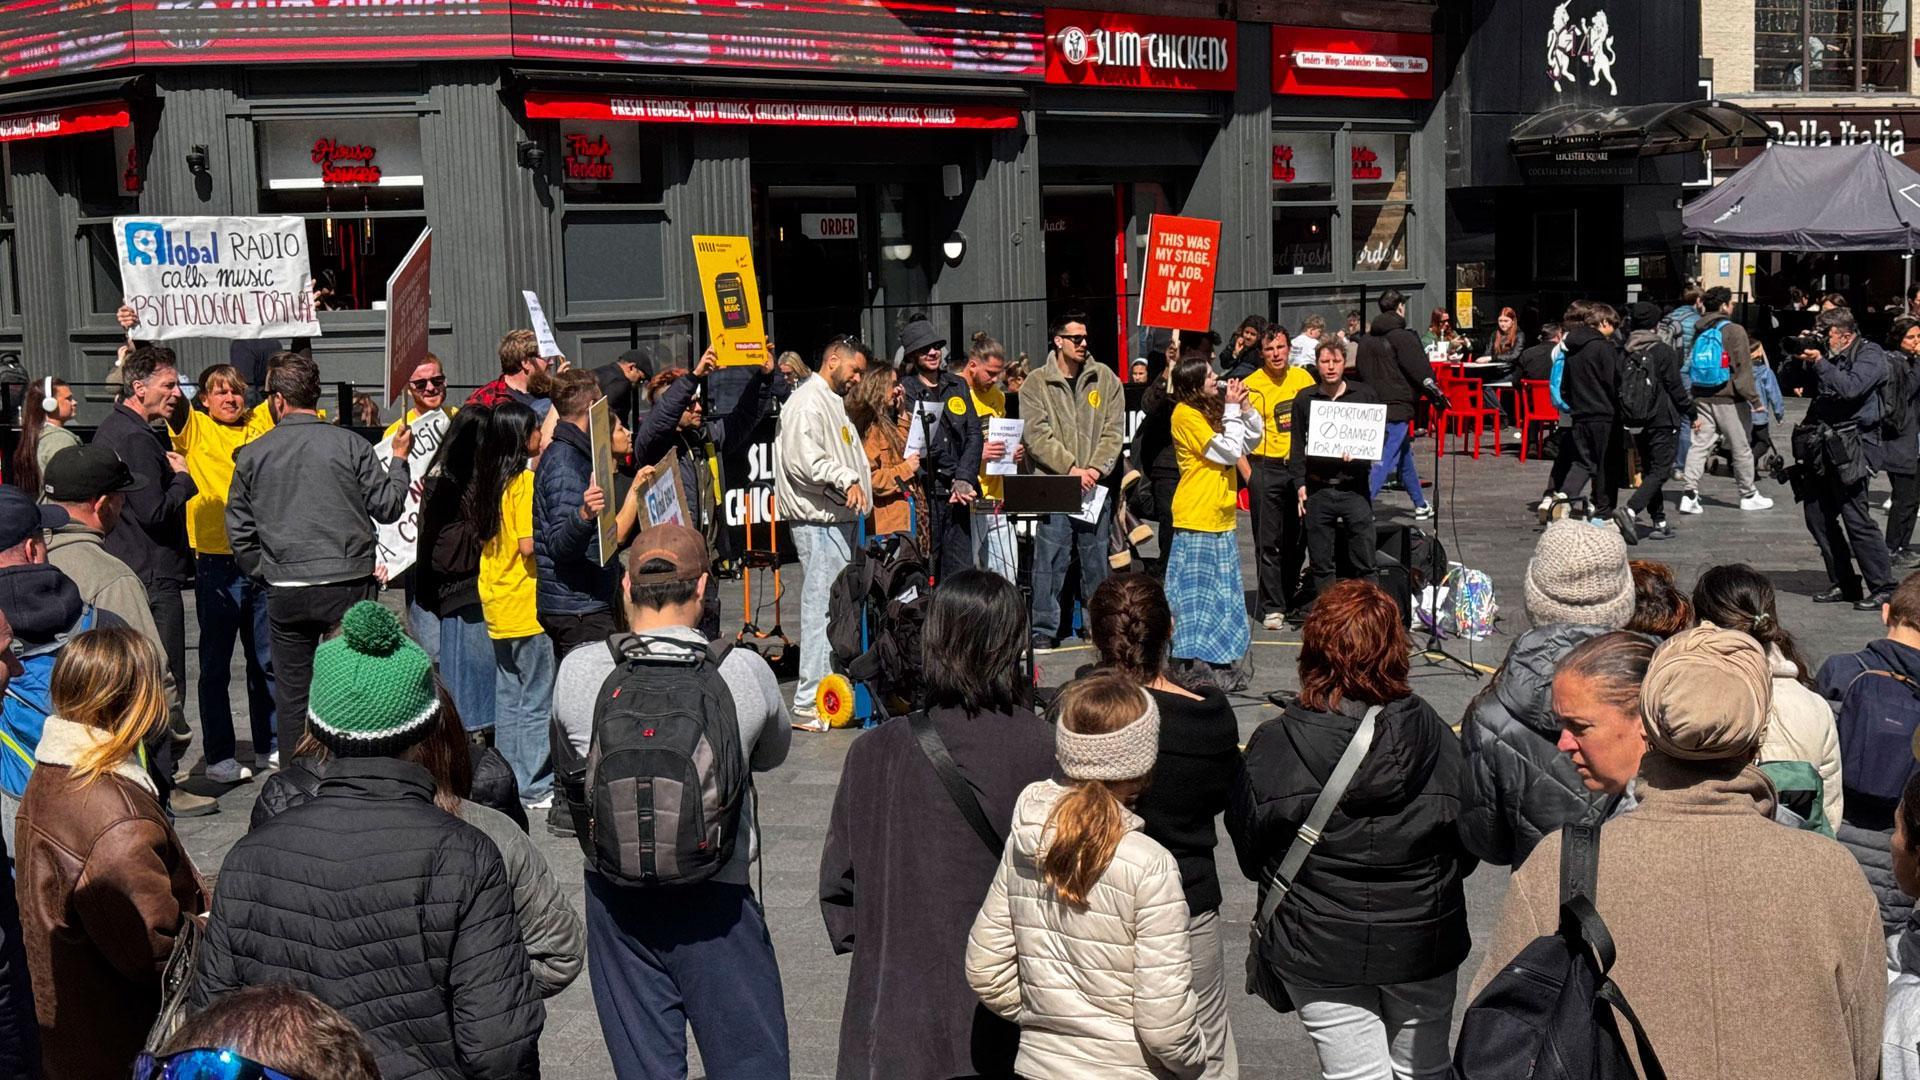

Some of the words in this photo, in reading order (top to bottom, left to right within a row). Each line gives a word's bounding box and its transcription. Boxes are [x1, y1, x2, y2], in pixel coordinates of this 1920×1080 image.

[1097, 29, 1141, 66] SLIM
[1148, 34, 1229, 72] CHICKENS
[1302, 53, 1320, 65] Tenders
[611, 98, 644, 116] FRESH
[645, 100, 694, 121] TENDERS,
[695, 101, 715, 118] HOT
[717, 102, 754, 123] WINGS,
[755, 103, 796, 121] CHICKEN
[796, 104, 857, 125] SANDWICHES,
[858, 106, 887, 122] HOUSE
[888, 107, 923, 126] SAUCES,
[924, 108, 955, 124] SHAKES
[311, 138, 376, 163] House
[1556, 152, 1585, 160] LEICESTER
[1586, 152, 1608, 162] SQUARE
[322, 160, 381, 183] Sauces
[820, 218, 855, 236] ORDER
[229, 232, 300, 261] RADIO
[1158, 232, 1184, 247] THIS
[1186, 235, 1211, 250] WAS
[1155, 247, 1172, 261] MY
[1174, 249, 1211, 267] STAGE,
[161, 264, 208, 289] calls
[216, 262, 275, 288] music
[1158, 263, 1176, 278] MY
[1178, 267, 1204, 283] JOB,
[1166, 279, 1191, 297] MY
[250, 289, 319, 326] TORTURE
[1160, 297, 1193, 315] JOY.
[1339, 424, 1377, 442] BANNED
[1313, 441, 1330, 454] FOR
